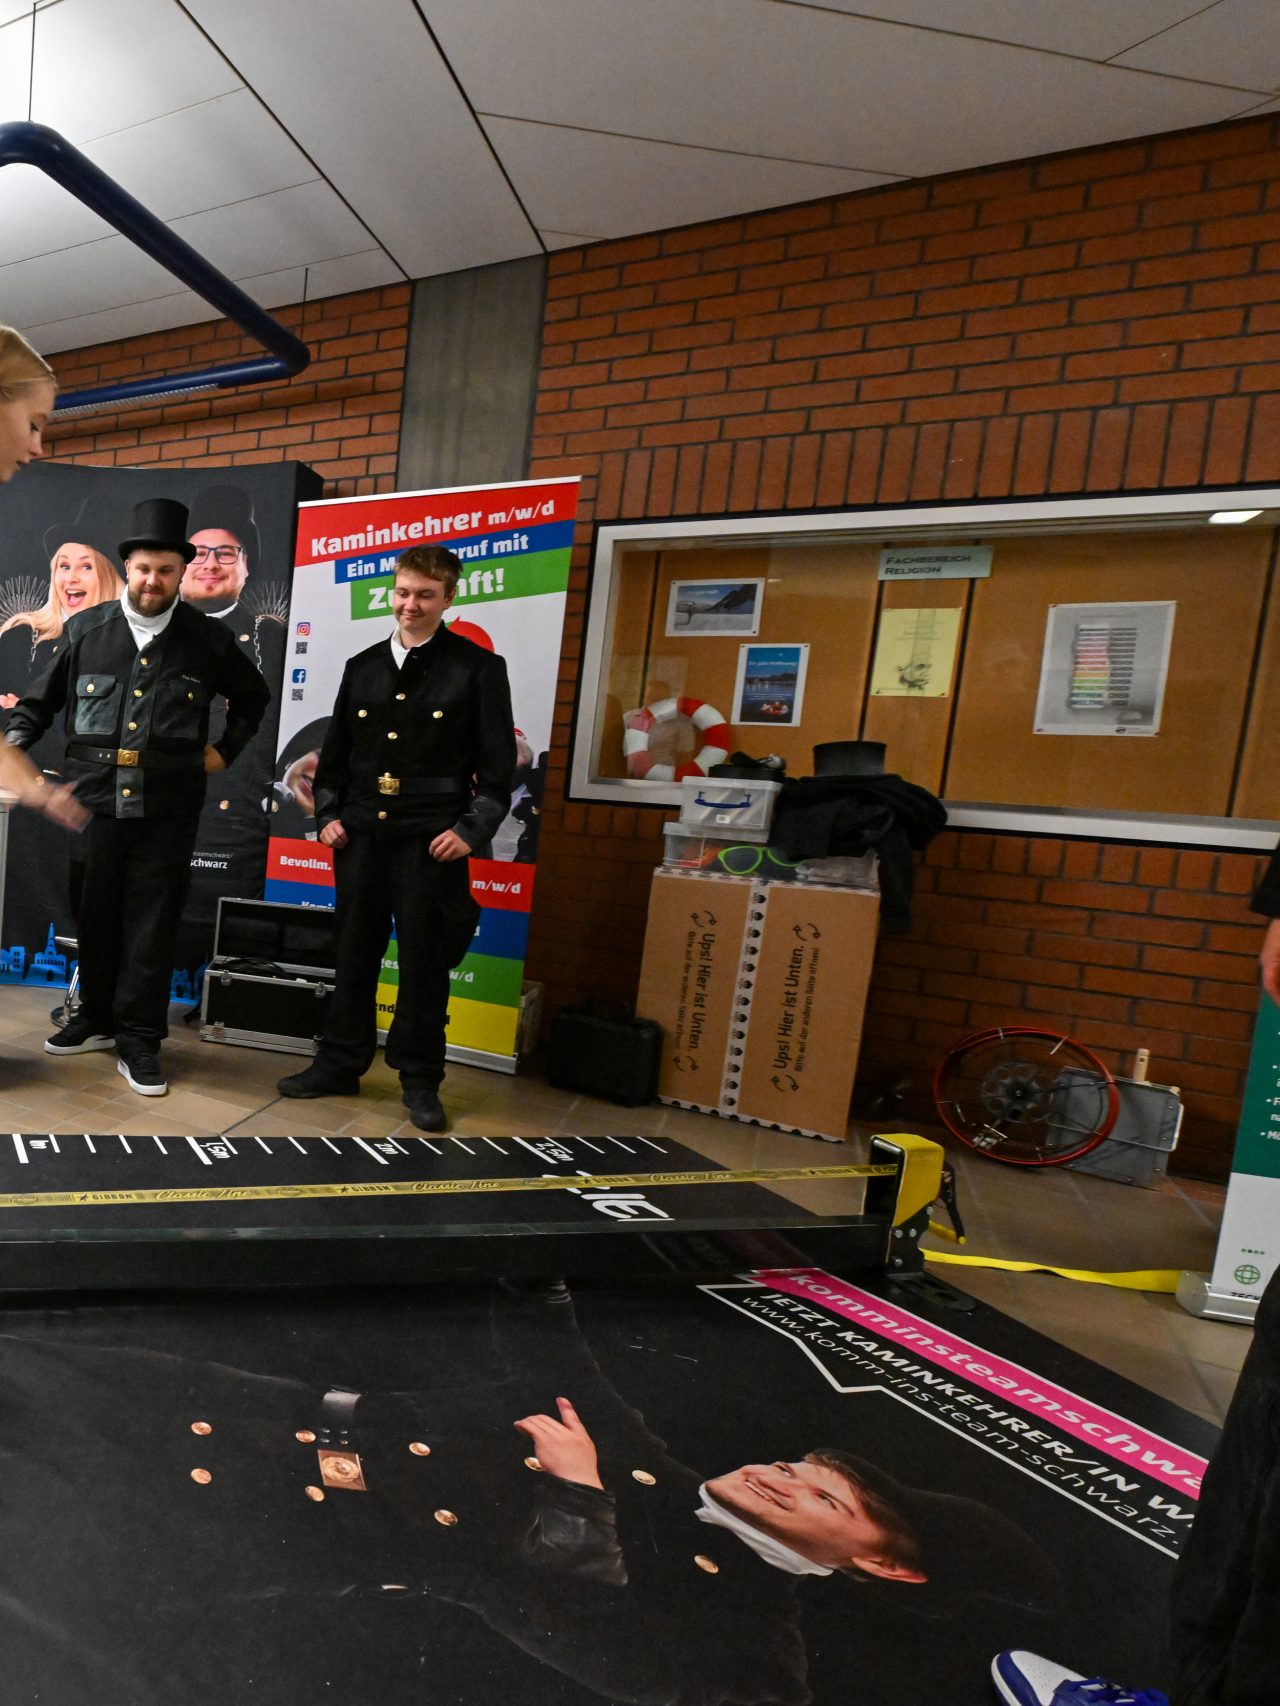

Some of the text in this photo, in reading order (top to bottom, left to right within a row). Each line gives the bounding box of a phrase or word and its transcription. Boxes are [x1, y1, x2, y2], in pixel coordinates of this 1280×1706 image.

[311, 499, 555, 557] Kaminkehrer m/w/d
[347, 559, 376, 578] Ein
[379, 556, 397, 573] M
[492, 533, 529, 553] mit
[280, 855, 332, 871] Bevollm.
[472, 879, 521, 894] m/w/d
[449, 971, 474, 983] w/d
[696, 964, 711, 990] Hier
[693, 992, 708, 1009] ist
[773, 945, 804, 1069] Ups! Hier ist Unten.
[156, 1189, 209, 1201] Classic
[412, 1182, 464, 1193] Classic
[470, 1180, 503, 1191] Line
[649, 1172, 700, 1183] Classic
[705, 1171, 734, 1181] Line
[761, 1293, 840, 1328] JETZT
[836, 1331, 1141, 1492] KAMINKEHRER/IN
